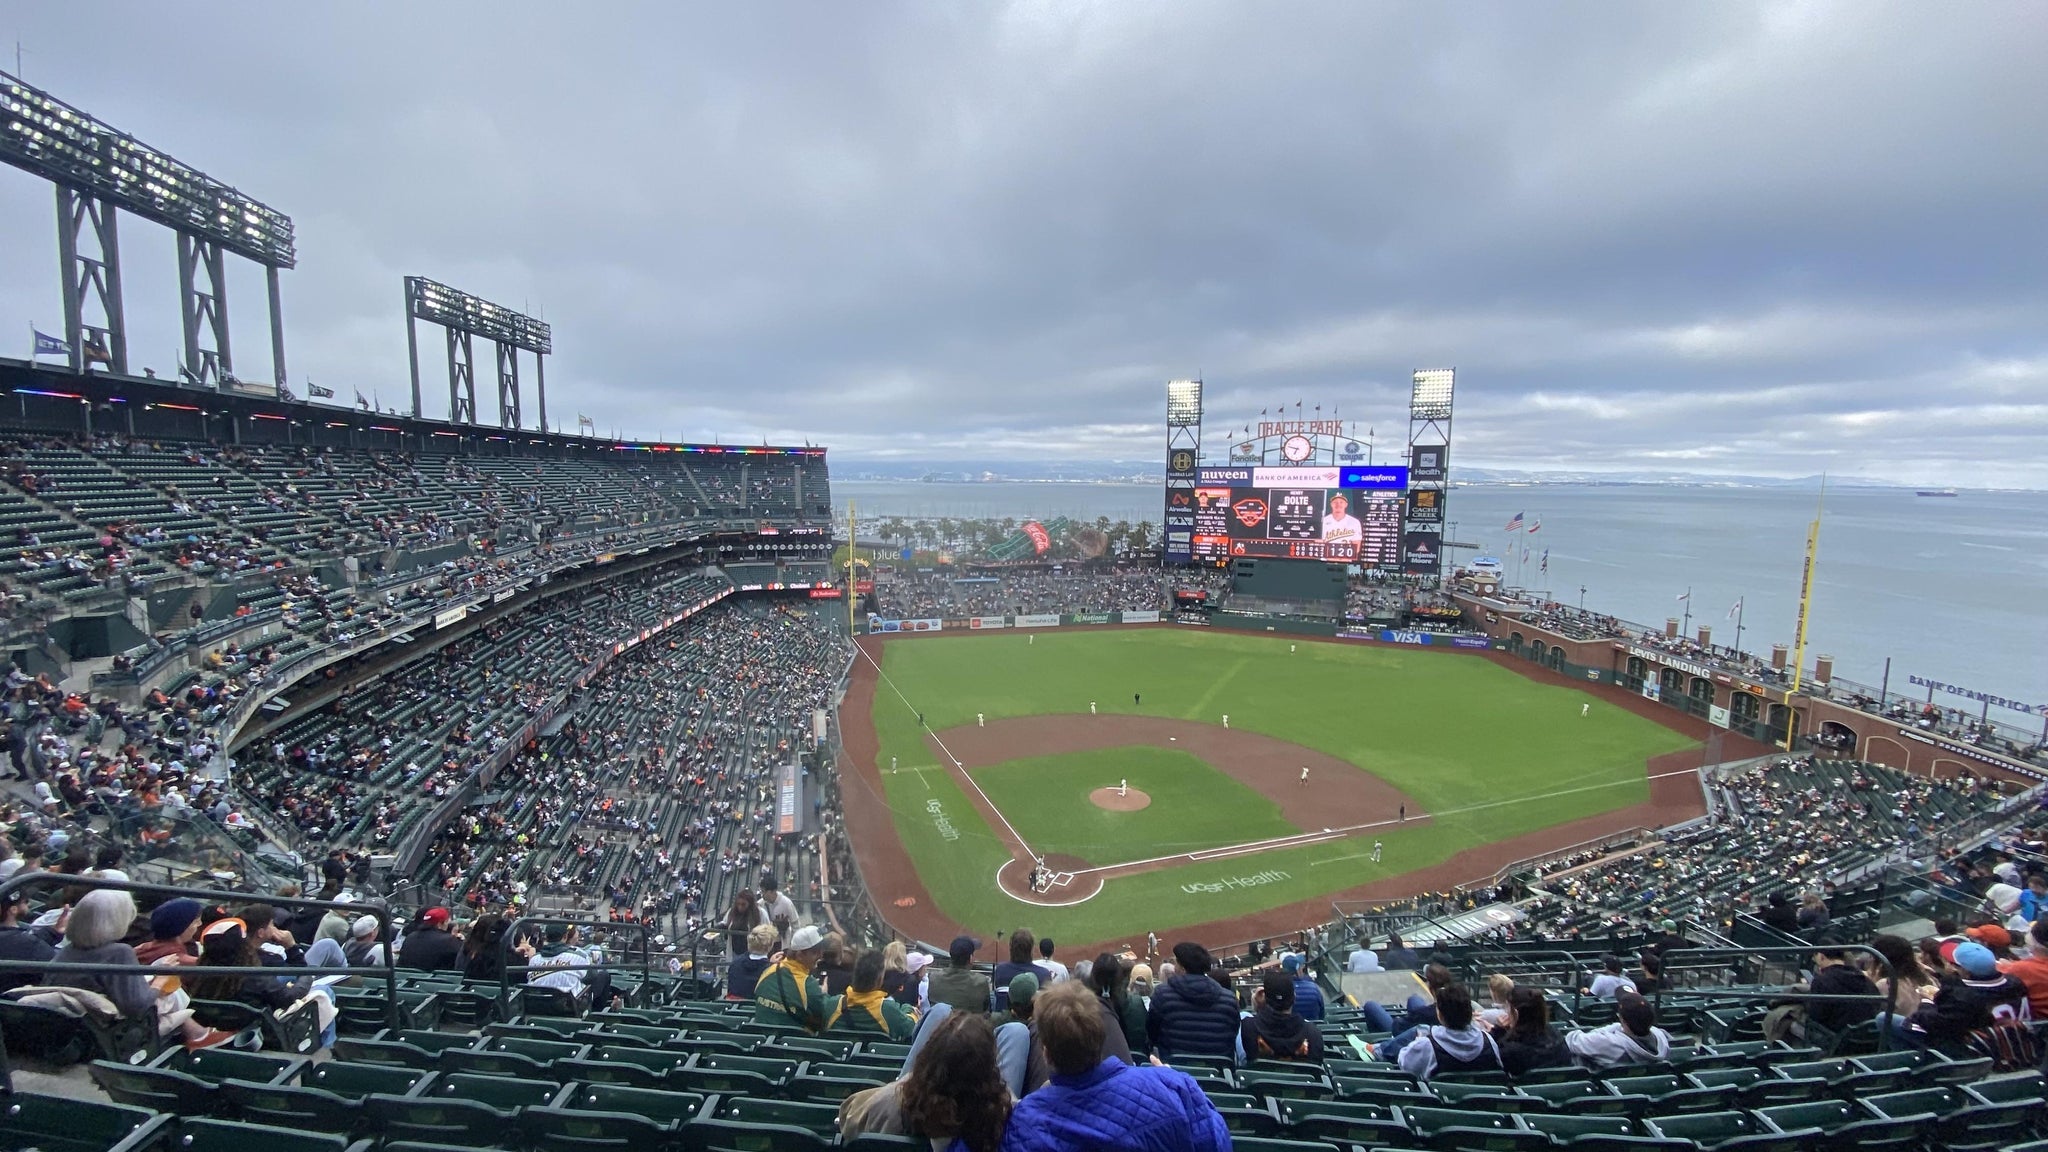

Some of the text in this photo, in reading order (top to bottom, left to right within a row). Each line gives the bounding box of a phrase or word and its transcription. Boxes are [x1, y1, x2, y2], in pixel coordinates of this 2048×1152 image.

[1258, 420, 1342, 438] ORACLE PARK
[1231, 454, 1262, 463] Fanatics
[1201, 471, 1249, 479] nuveen
[1415, 468, 1440, 476] Health
[1361, 474, 1397, 482] salesforce
[1284, 496, 1309, 505] BOLTE
[873, 549, 900, 560] blue
[1407, 551, 1437, 559] Benjamin
[1393, 633, 1422, 644] VISA
[1659, 655, 1711, 679] LANDING
[1909, 675, 2031, 713] BANK OF AMERICA
[1221, 870, 1292, 889] Health
